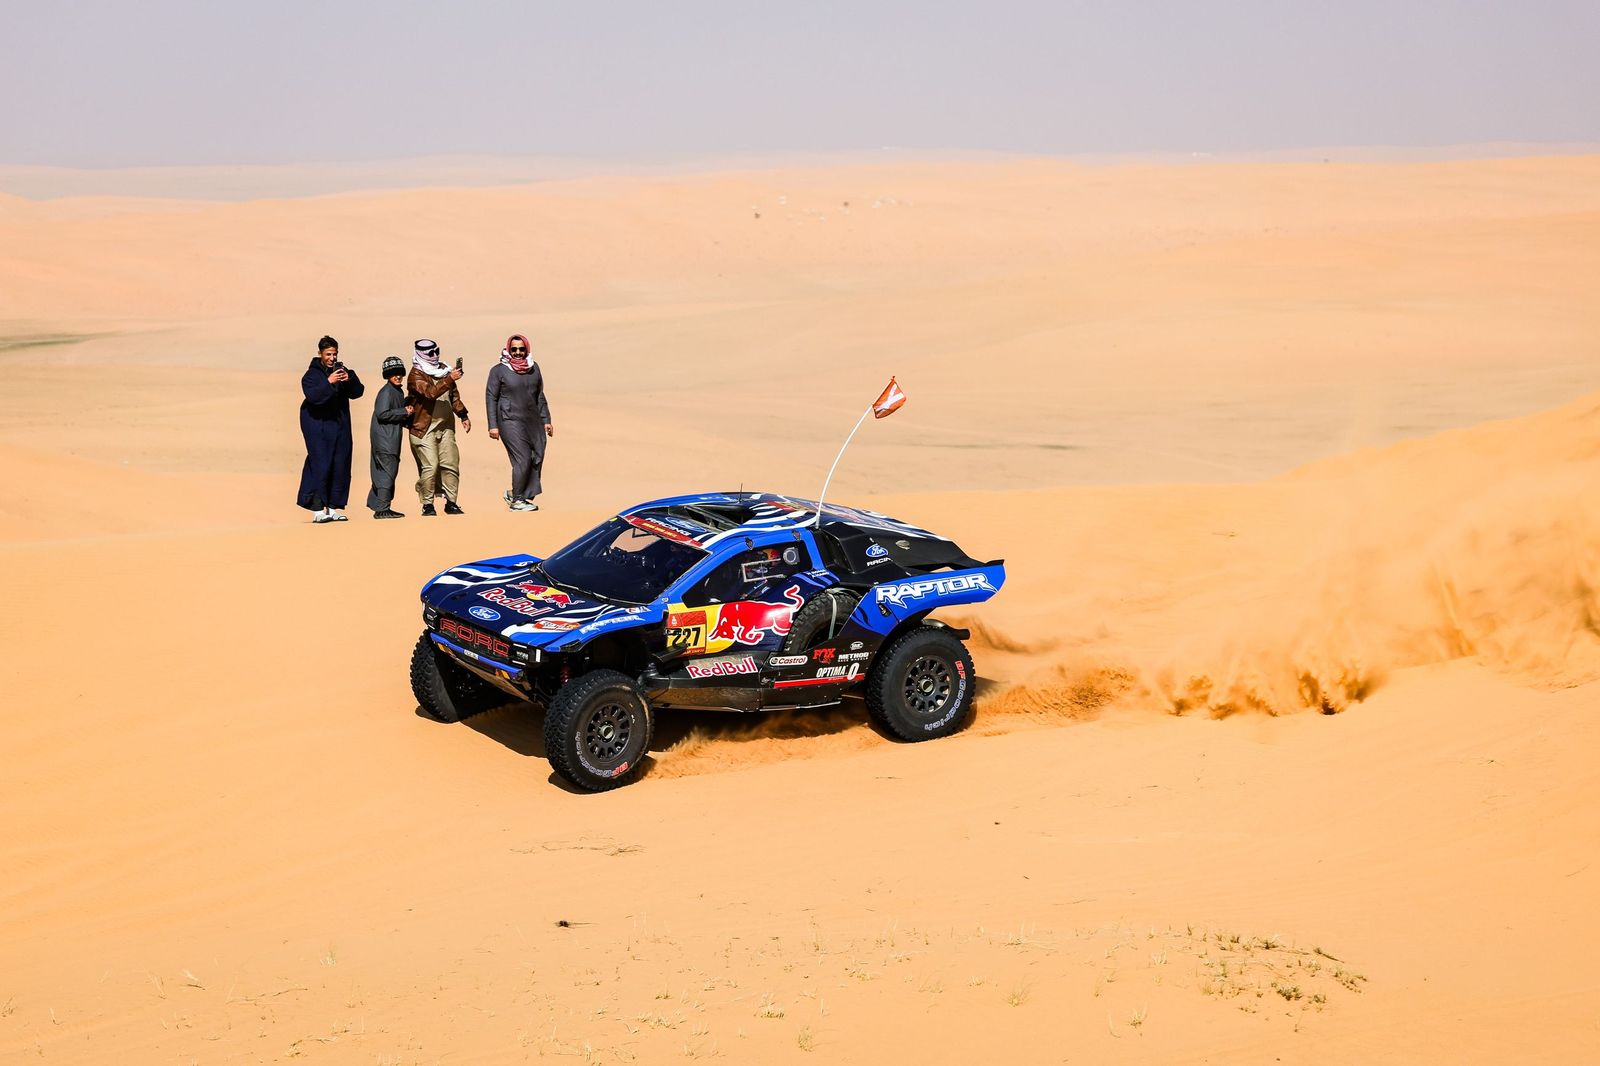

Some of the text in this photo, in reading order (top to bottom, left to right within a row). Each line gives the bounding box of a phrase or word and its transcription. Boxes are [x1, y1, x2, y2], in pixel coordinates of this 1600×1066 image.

[477, 587, 525, 606] Red
[876, 573, 998, 608] RAPTOR
[440, 618, 510, 657] FORD
[778, 657, 806, 665] Castrol
[812, 648, 836, 663] FOX
[838, 652, 869, 660] METHOD
[686, 656, 758, 679] Red Bull
[816, 665, 847, 678] OPTIMA
